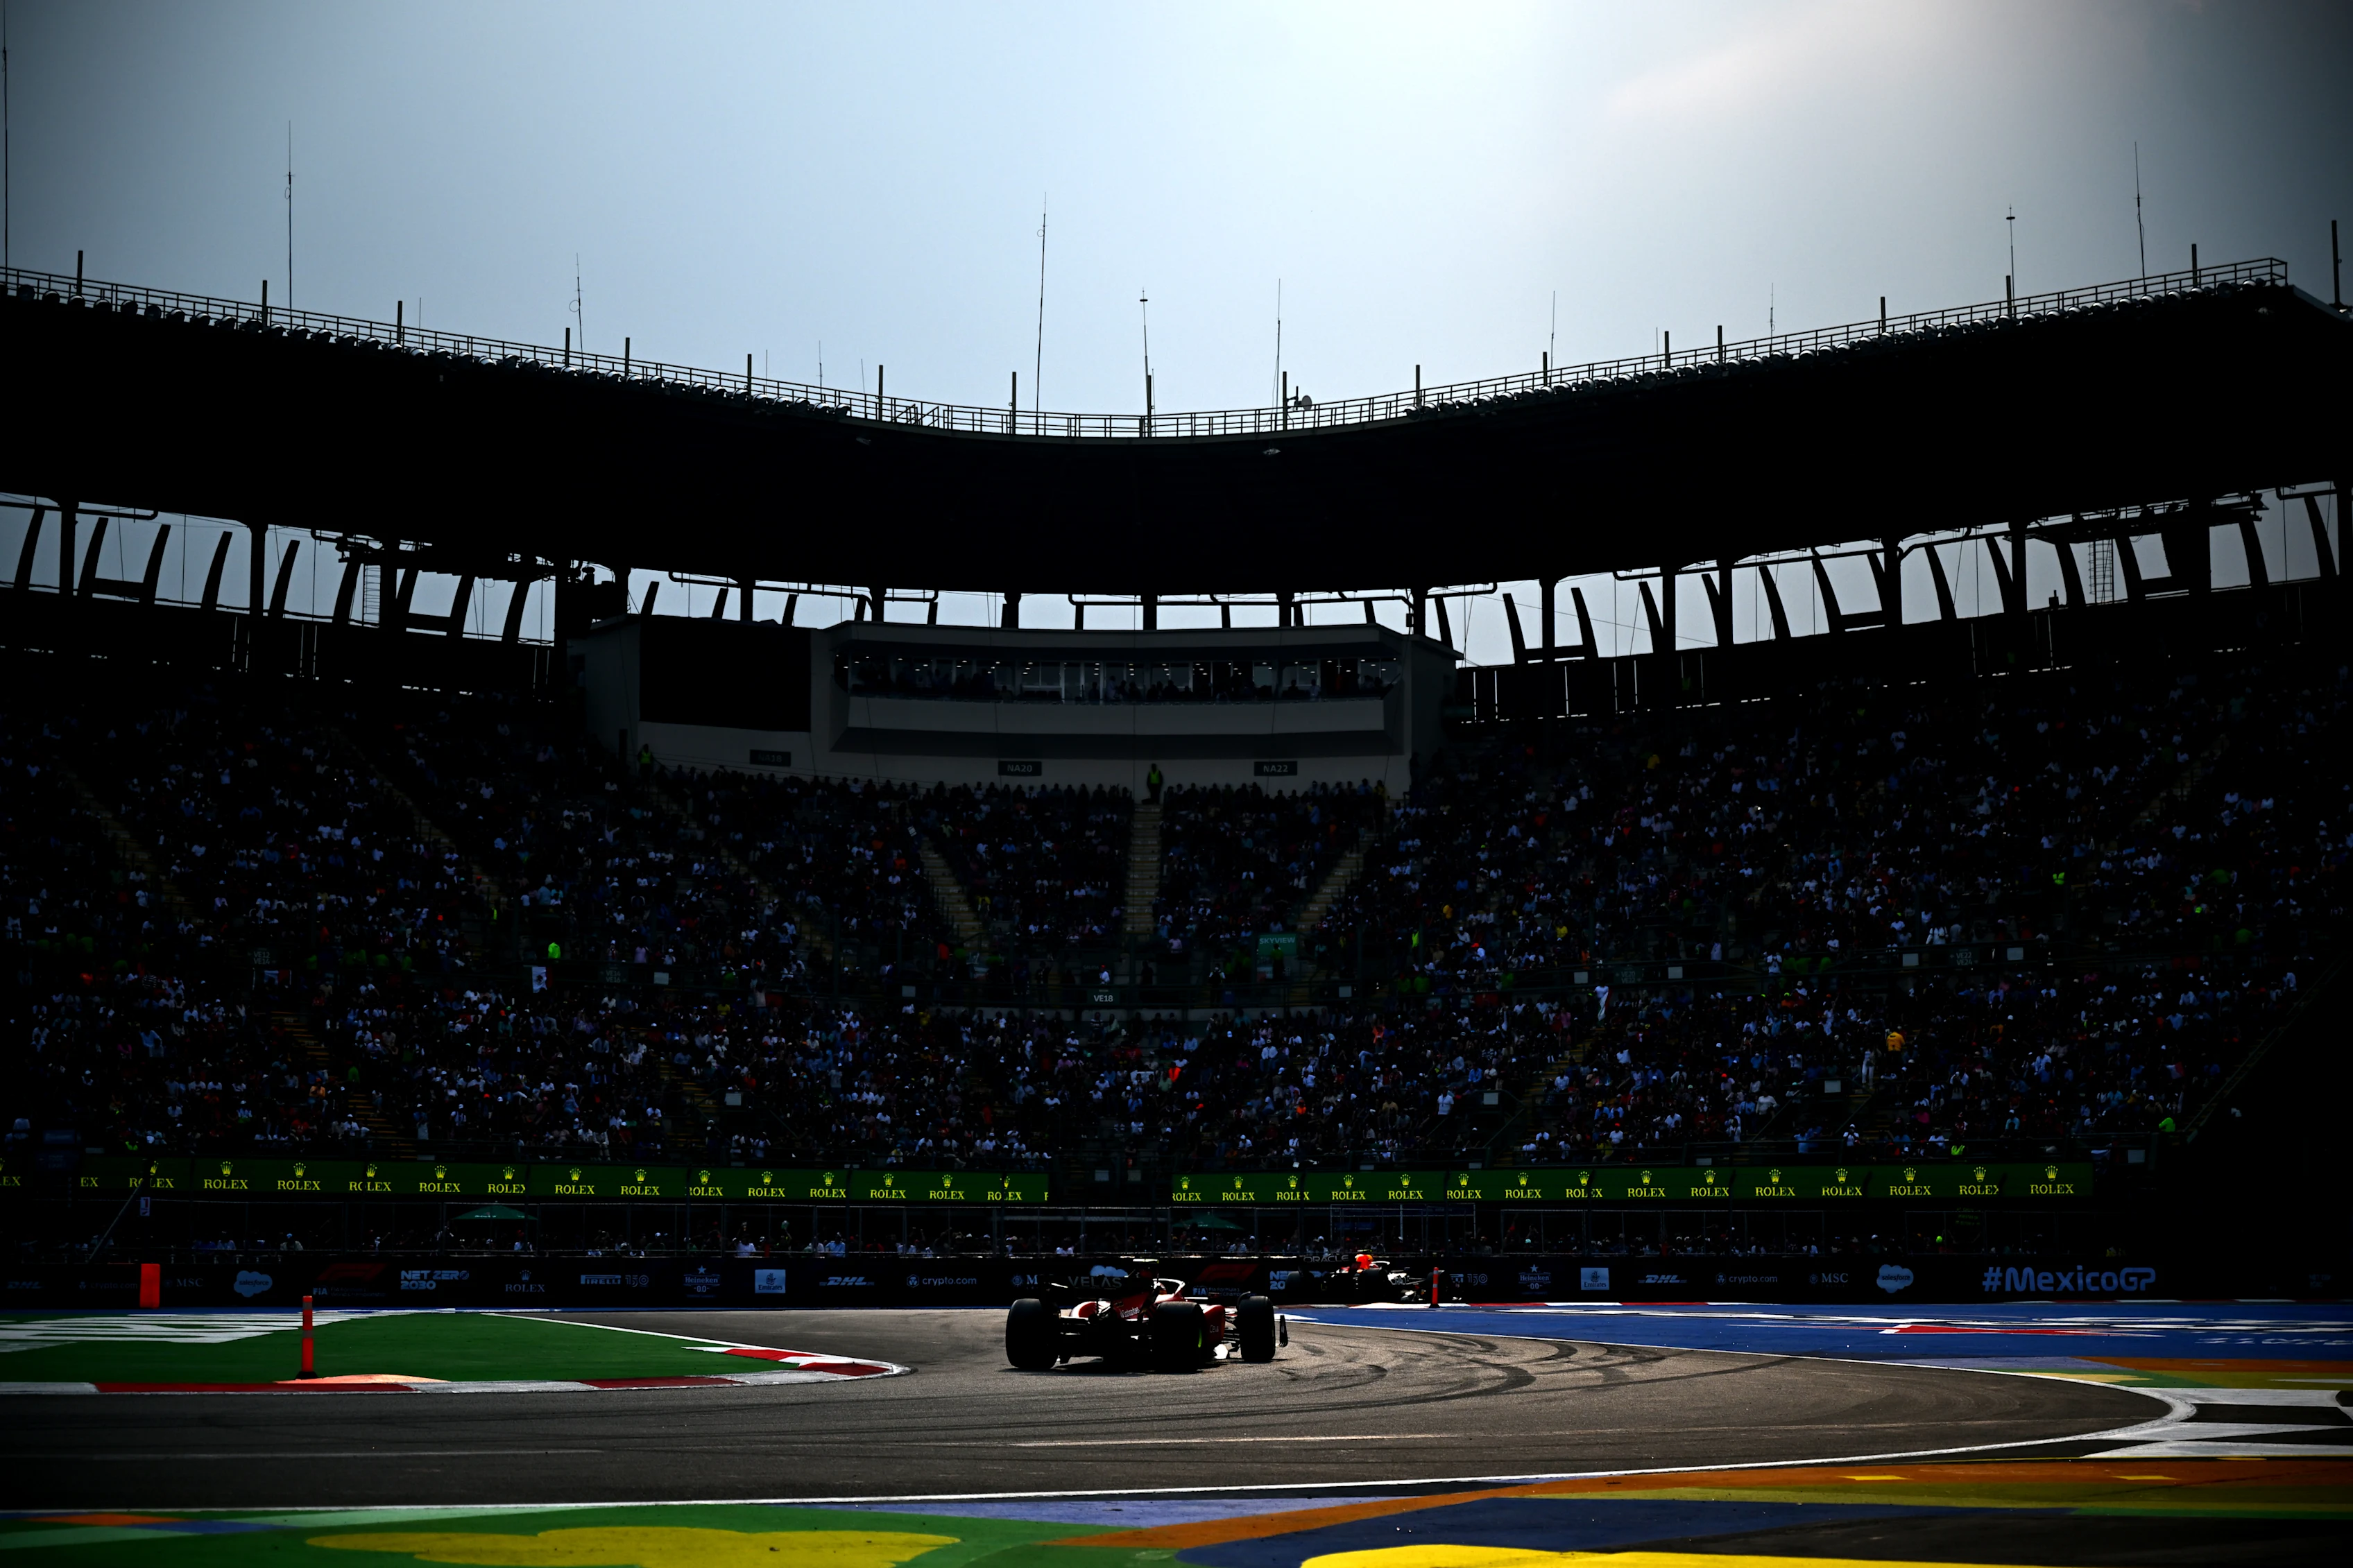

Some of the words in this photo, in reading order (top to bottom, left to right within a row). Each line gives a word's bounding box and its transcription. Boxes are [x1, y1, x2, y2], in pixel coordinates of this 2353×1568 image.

[1007, 764, 1033, 773] NA20
[1263, 765, 1288, 773] NA22
[1093, 994, 1114, 1003] VE18
[204, 1179, 248, 1189] ROLEX
[277, 1180, 320, 1191] ROLEX
[420, 1182, 461, 1193] ROLEX
[555, 1184, 594, 1195] ROLEX
[620, 1185, 660, 1196] ROLEX
[748, 1187, 786, 1198] ROLEX
[810, 1188, 846, 1198] ROLEX
[870, 1189, 907, 1199] ROLEX
[1446, 1189, 1482, 1199] ROLEX
[1505, 1189, 1541, 1199] ROLEX
[1627, 1187, 1666, 1198] ROLEX
[1691, 1187, 1729, 1197] ROLEX
[1755, 1187, 1796, 1196] ROLEX
[1822, 1187, 1863, 1196] ROLEX
[1889, 1185, 1931, 1196] ROLEX
[2030, 1184, 2074, 1195] ROLEX
[929, 1190, 965, 1200] ROLEX
[1222, 1191, 1255, 1201] ROLEX
[1331, 1191, 1366, 1200] ROLEX
[1388, 1190, 1423, 1200] ROLEX
[1303, 1255, 1349, 1263] ORACLE
[400, 1270, 431, 1280] NET
[434, 1270, 470, 1281] ZERO
[580, 1274, 622, 1284] PIRELLI
[624, 1275, 649, 1287] 150
[1645, 1274, 1679, 1284] DHL
[1729, 1275, 1778, 1284] crypto.com
[1821, 1273, 1849, 1283] MSC
[1982, 1265, 2156, 1293] #MexicoGP
[176, 1277, 204, 1288] MSC
[238, 1280, 270, 1288] salesforce
[400, 1280, 437, 1291] 2030
[827, 1277, 867, 1286] DHL
[922, 1277, 977, 1286] crypto.com
[1067, 1275, 1122, 1288] VELAS
[313, 1287, 328, 1295] FIA
[504, 1284, 545, 1293] ROLEX
[1192, 1287, 1208, 1296] FIA
